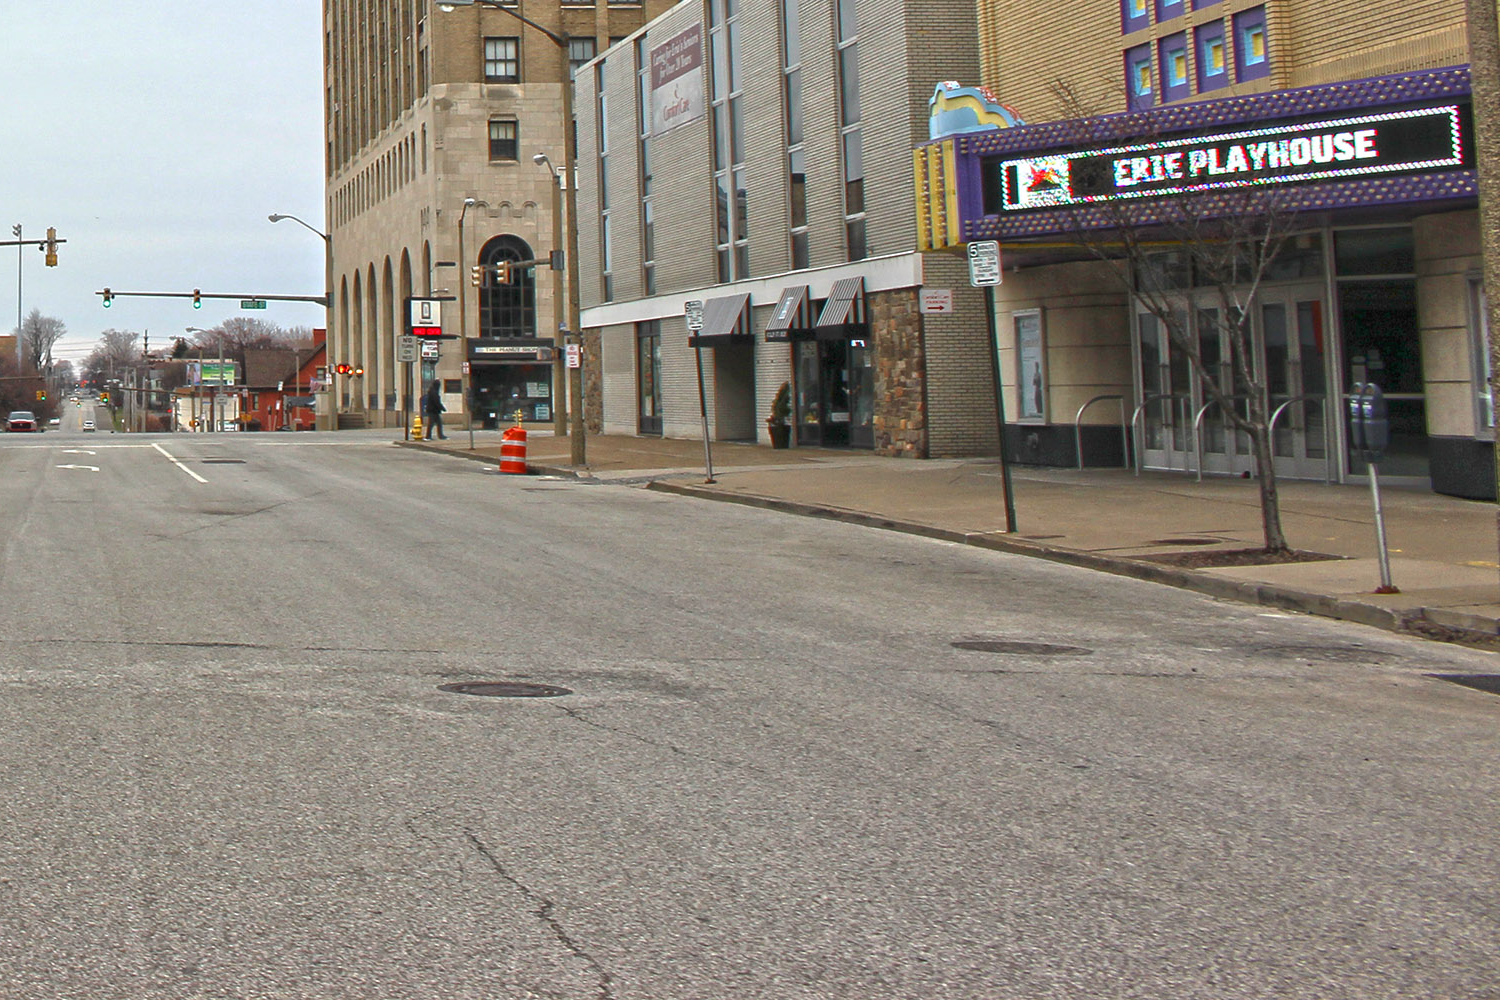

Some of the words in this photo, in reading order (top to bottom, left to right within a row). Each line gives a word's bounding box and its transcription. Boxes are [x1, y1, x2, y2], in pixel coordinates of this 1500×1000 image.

[1113, 151, 1184, 187] ERIE
[1188, 129, 1381, 177] PLAYHOUSE
[969, 245, 978, 257] 5
